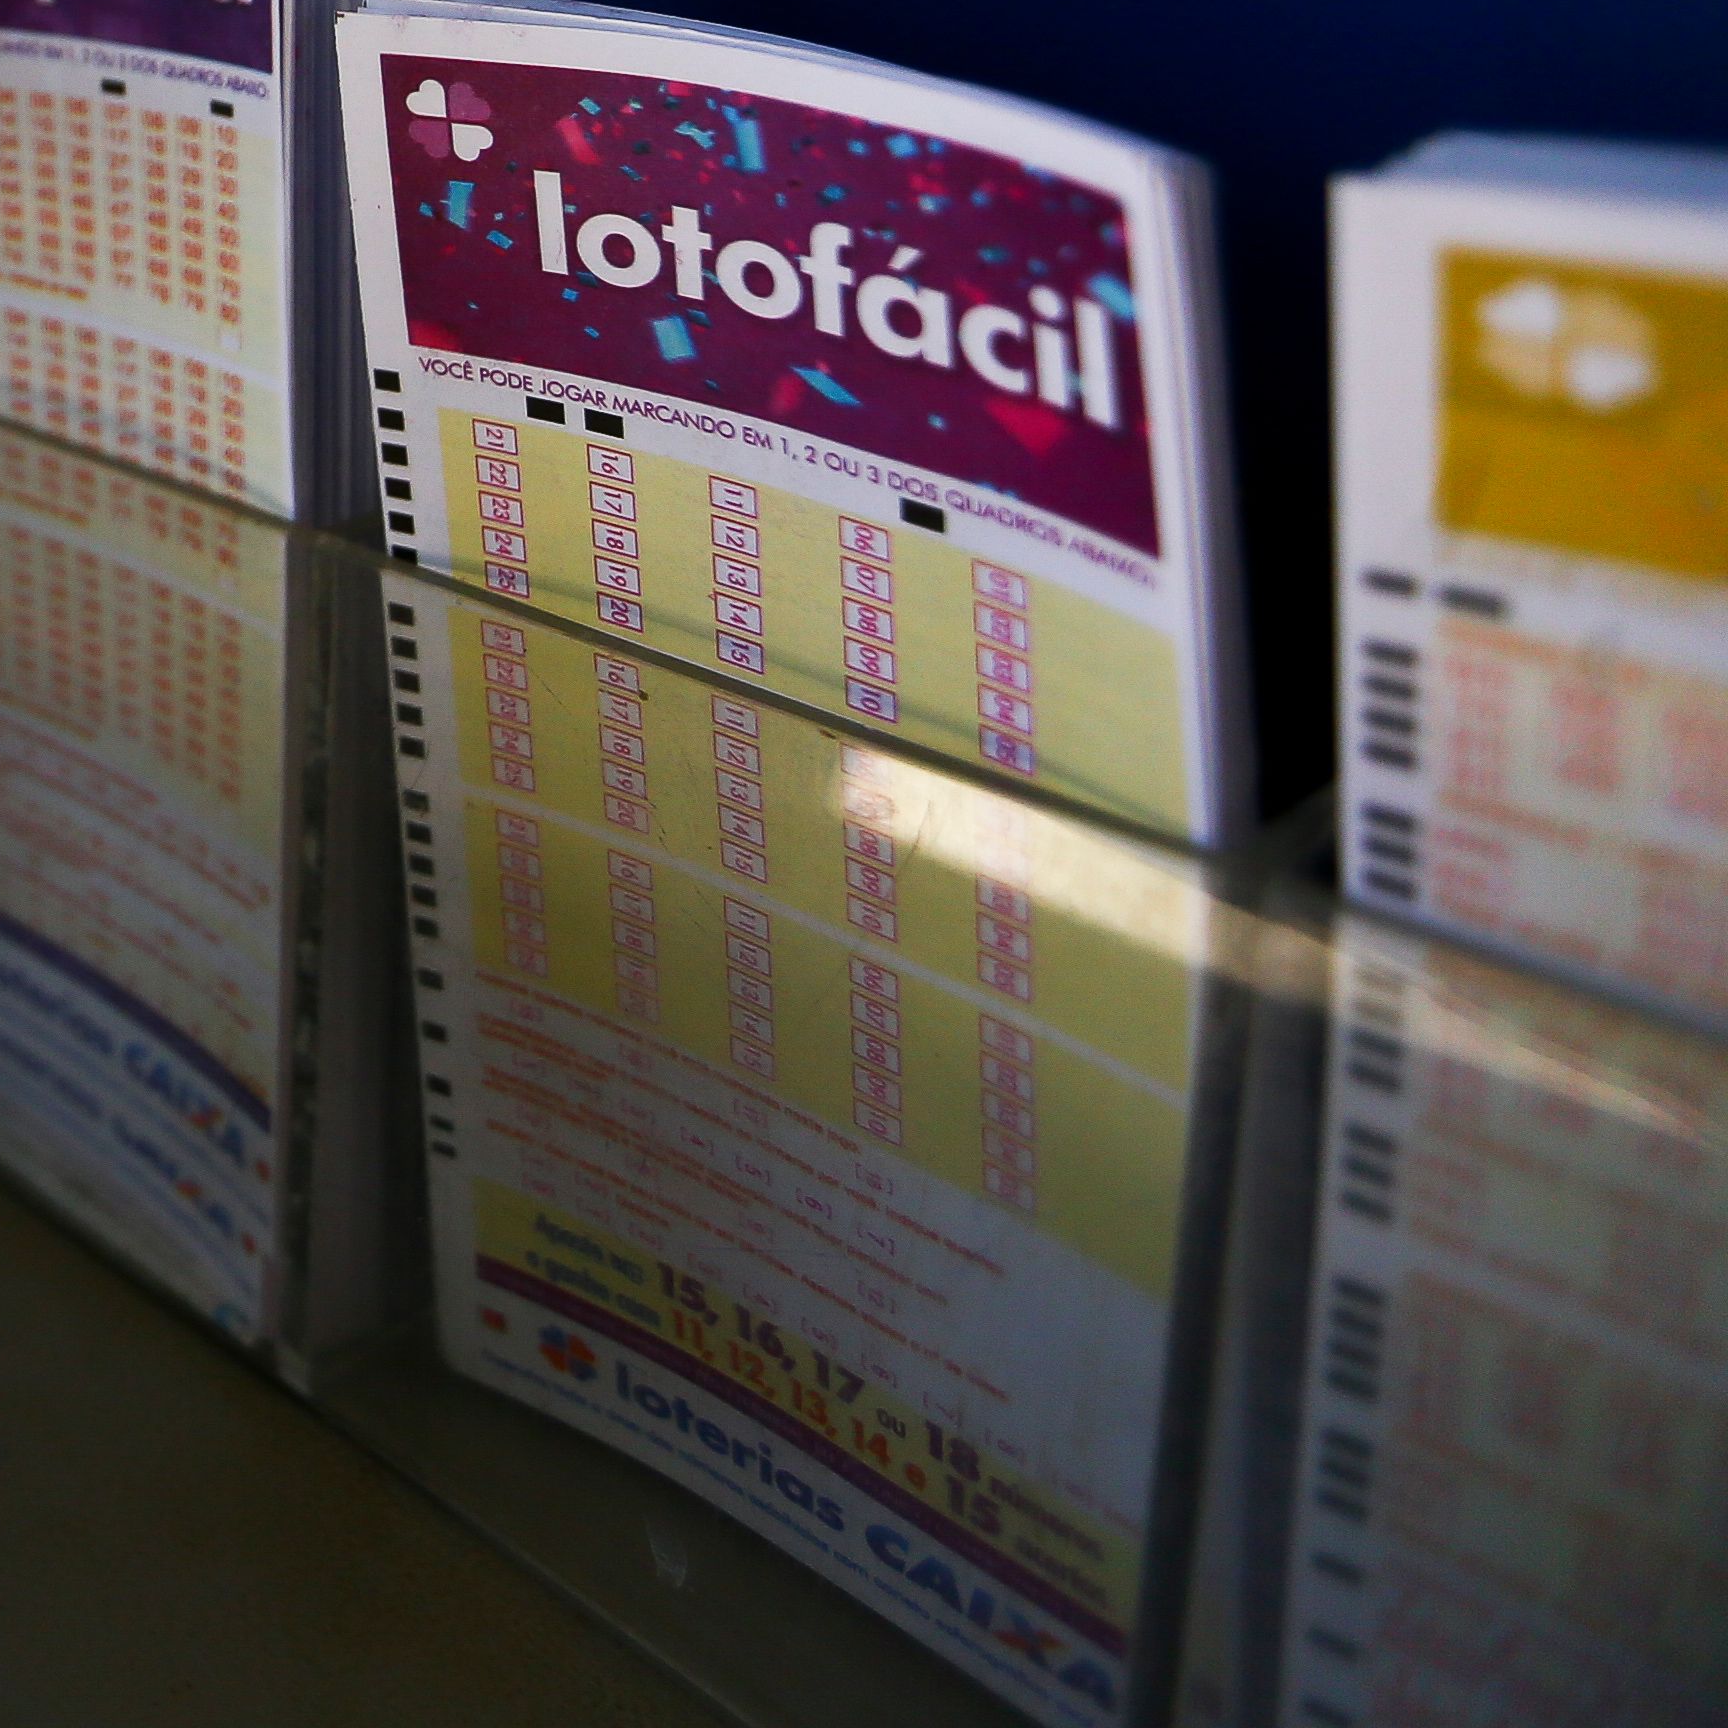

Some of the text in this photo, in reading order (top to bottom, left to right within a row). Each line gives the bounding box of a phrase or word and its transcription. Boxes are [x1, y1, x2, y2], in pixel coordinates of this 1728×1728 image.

[533, 169, 1121, 433] lotofácil
[417, 356, 474, 382] VOCÊ
[479, 368, 534, 393] PODE
[538, 379, 607, 409] JOGAR
[612, 394, 736, 440] MARCANDO
[741, 427, 771, 451] EM
[803, 445, 818, 465] 2
[822, 451, 858, 478] OU
[865, 464, 880, 485] 3
[887, 471, 939, 502] DOS
[484, 425, 517, 593] 21 22 23 24 25
[600, 452, 630, 625] 16 17 18 19 20
[722, 487, 750, 665] 11 12 13 14 15
[853, 525, 882, 713] 06 07 08 09 10
[606, 662, 627, 687] 16
[609, 697, 629, 721] 17
[612, 733, 632, 757] 18
[614, 768, 634, 792] 19
[724, 705, 754, 874] 11 12 13 14 15
[657, 1261, 718, 1326] 15,
[735, 1303, 796, 1372] 16,
[811, 1349, 865, 1403] 17
[875, 1406, 907, 1438] ou
[671, 1307, 715, 1362] 11,
[727, 1340, 776, 1399] 12,
[789, 1378, 837, 1438] 13,
[851, 1416, 891, 1465] 14
[615, 1359, 845, 1533] loterias
[863, 1524, 1119, 1710] CAIXA
